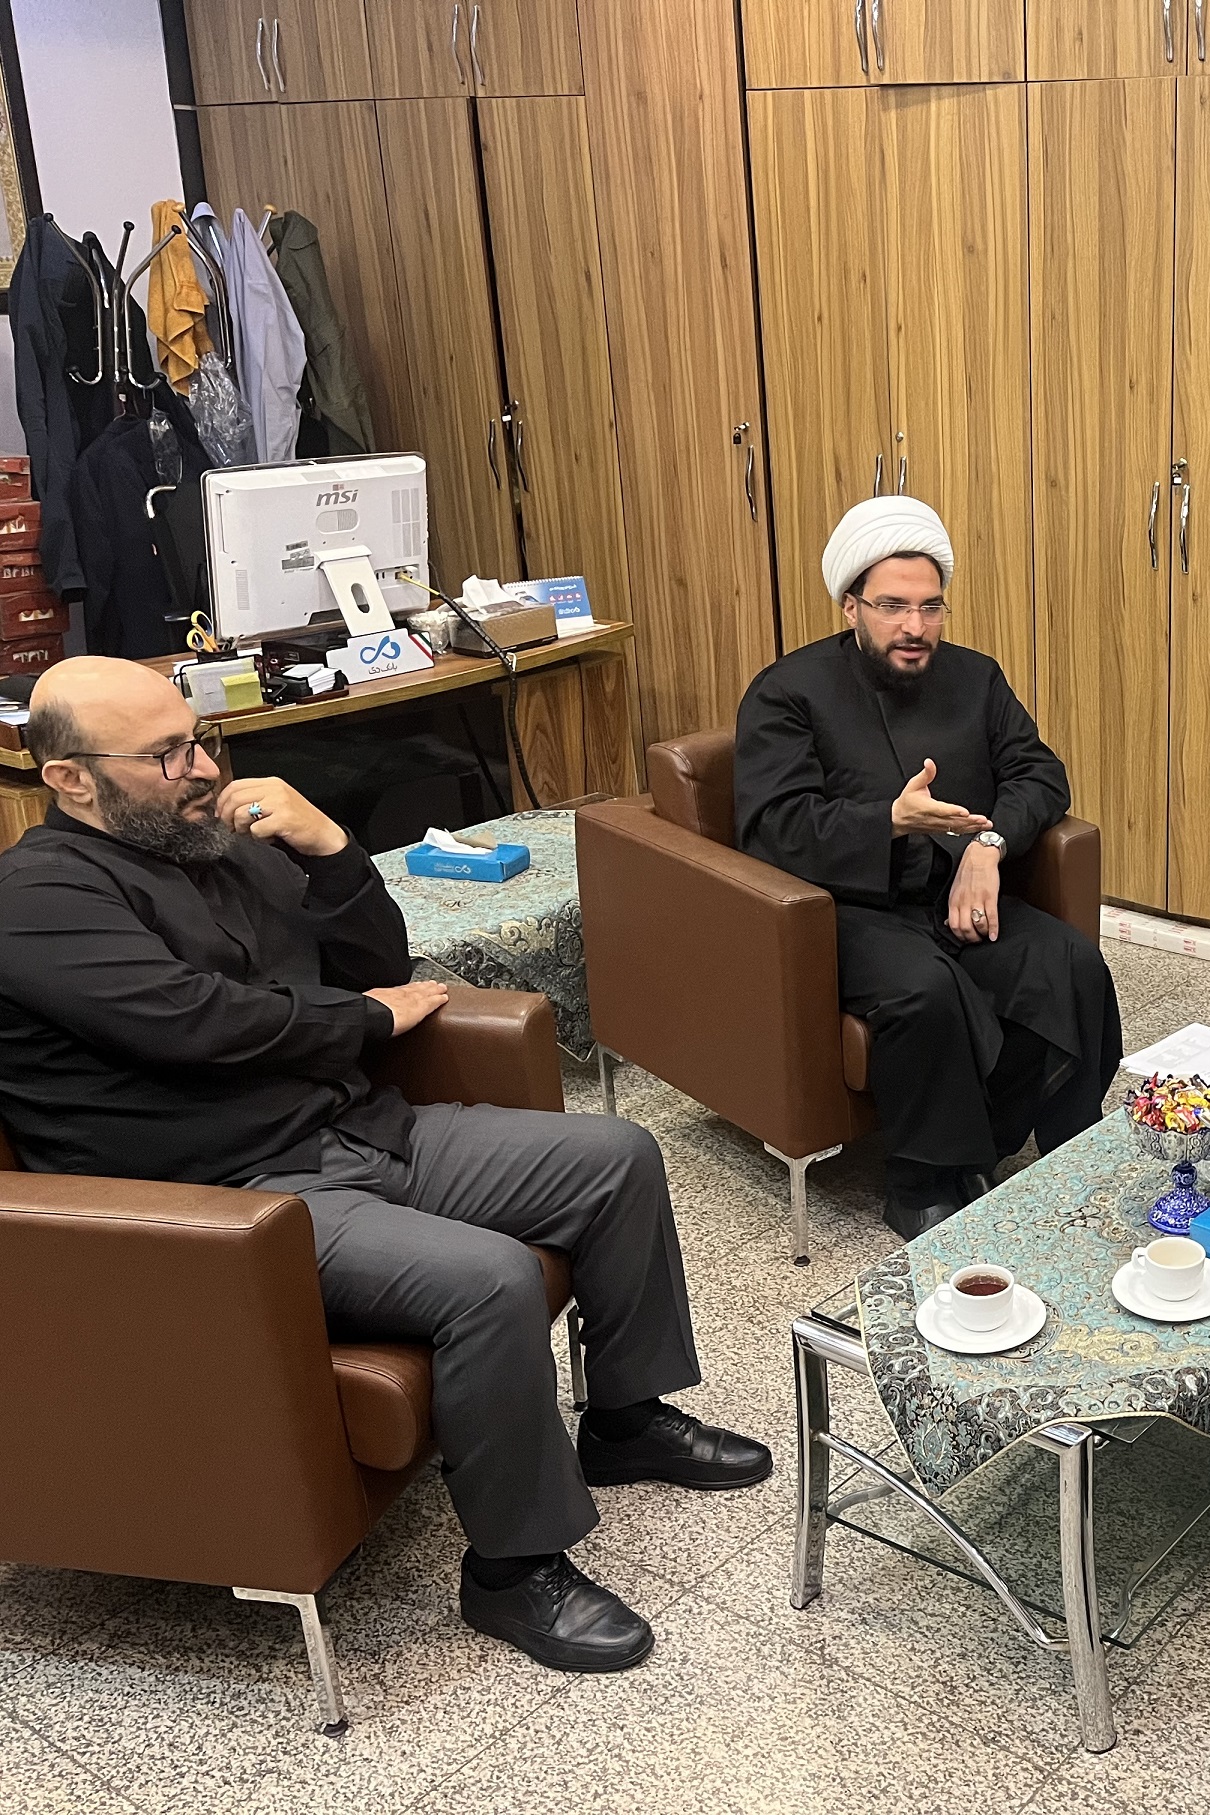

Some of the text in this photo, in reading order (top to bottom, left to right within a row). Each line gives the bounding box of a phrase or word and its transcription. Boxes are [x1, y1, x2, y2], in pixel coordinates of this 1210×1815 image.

[316, 488, 359, 507] msi
[368, 662, 398, 675] بانک دی
